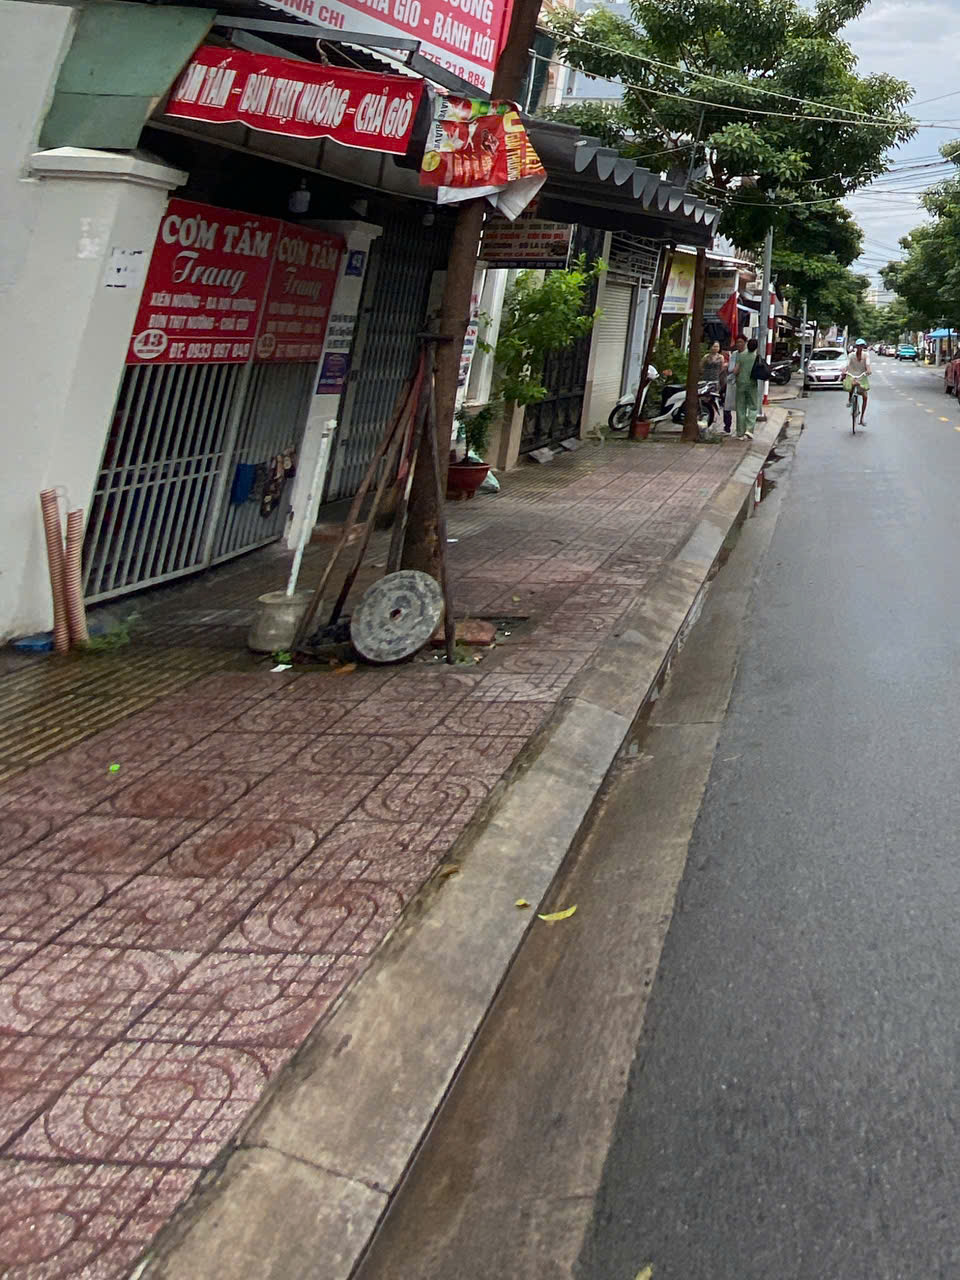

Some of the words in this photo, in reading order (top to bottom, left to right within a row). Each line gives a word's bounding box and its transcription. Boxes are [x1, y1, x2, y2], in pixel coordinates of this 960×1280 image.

[318, 5, 346, 30] CHI
[432, 11, 473, 53] BÁNH
[471, 29, 496, 63] HỎI
[174, 60, 208, 104] ƠM
[238, 68, 274, 116] BÚN
[267, 78, 305, 125] THỊT
[295, 80, 351, 128] NƯỚNG
[354, 86, 389, 136] CHẢ
[382, 91, 414, 140] GIÒ
[162, 214, 219, 250] CƠM
[222, 221, 272, 258] TẤM
[172, 250, 247, 296] Trang
[136, 332, 163, 347] 43
